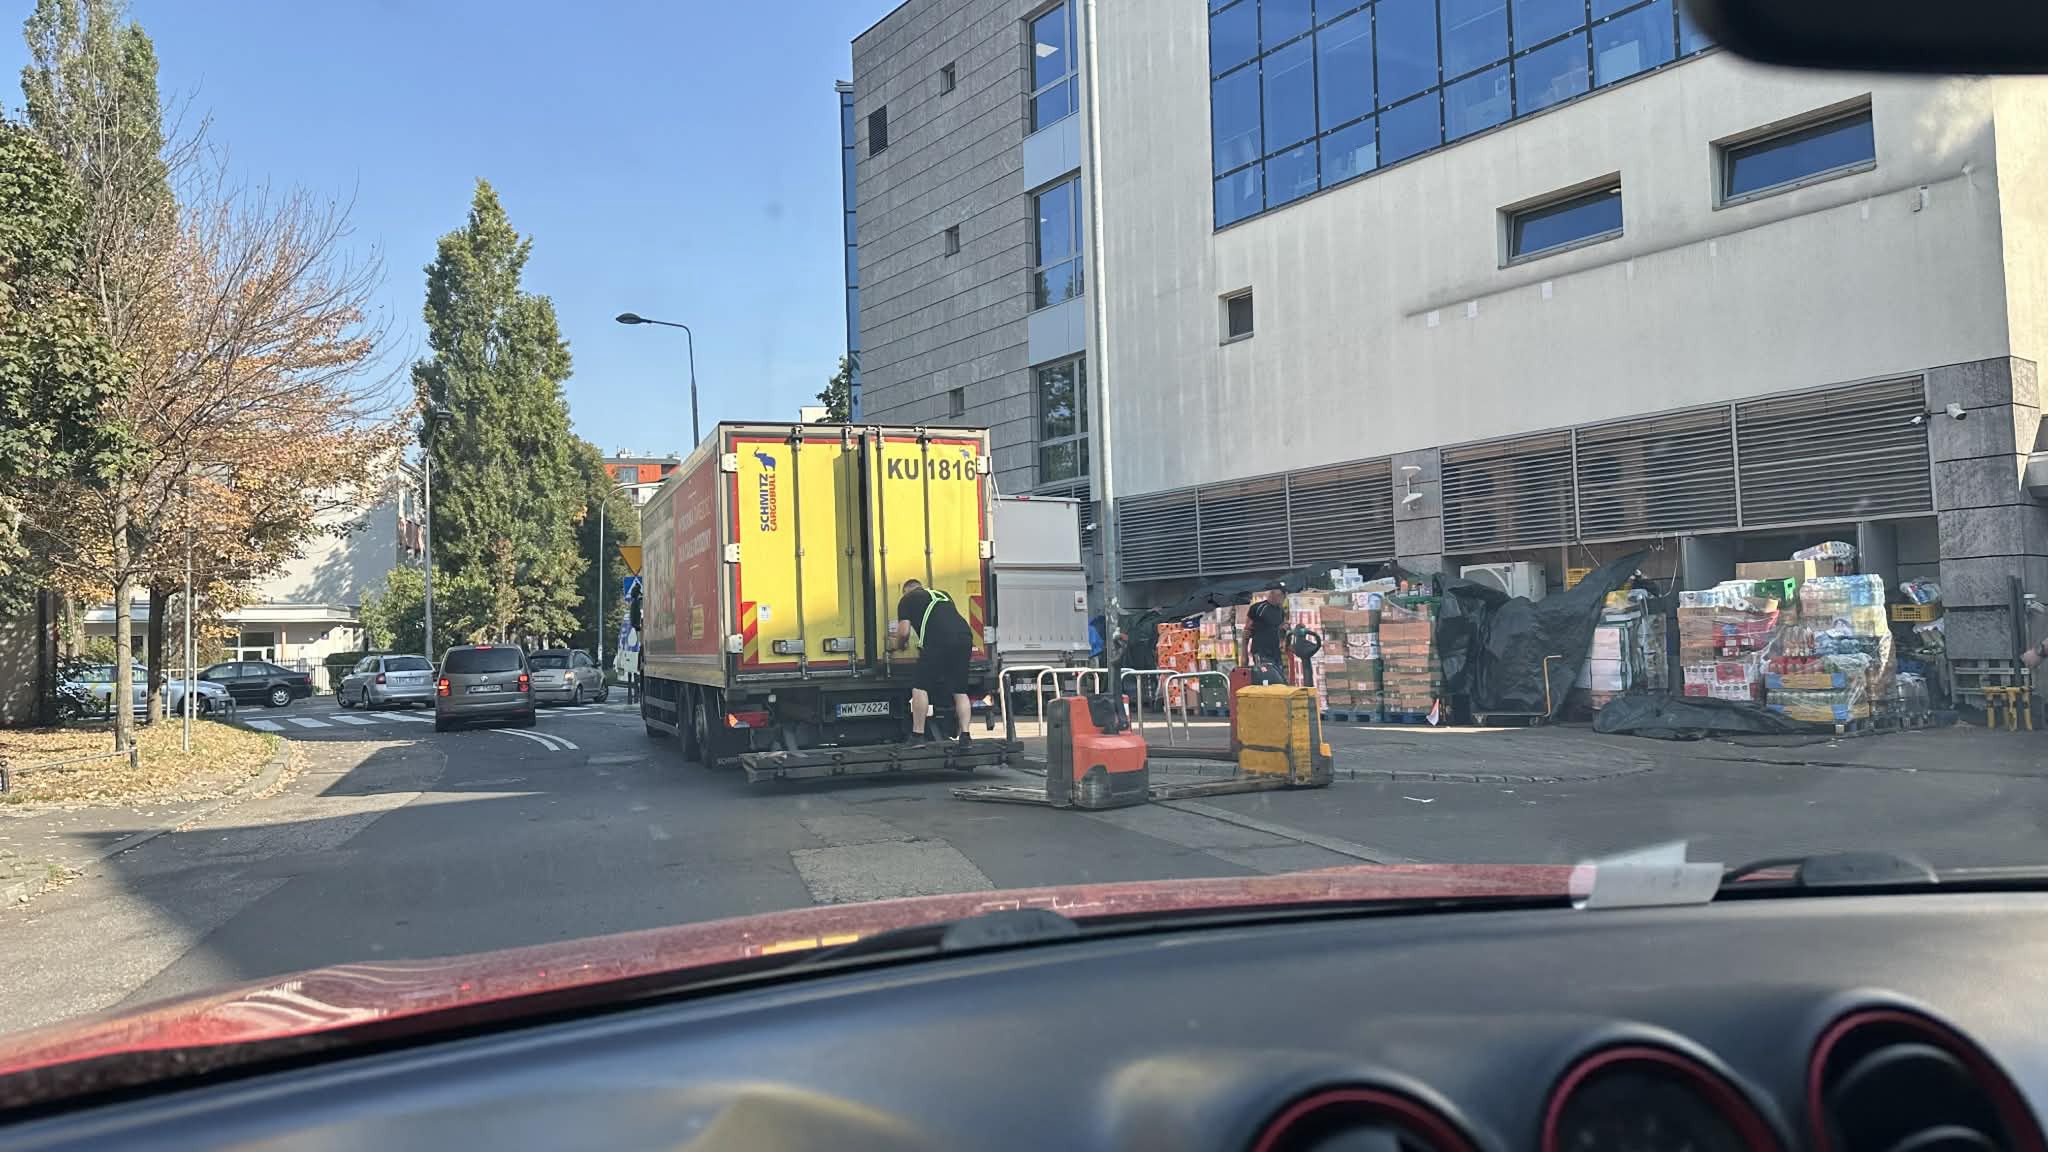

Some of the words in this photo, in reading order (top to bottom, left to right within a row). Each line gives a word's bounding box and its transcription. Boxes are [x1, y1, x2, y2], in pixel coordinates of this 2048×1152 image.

[888, 458, 919, 480] KU
[928, 458, 976, 481] 1816
[759, 473, 770, 532] SCHMITZ
[769, 473, 777, 532] CARGOBULL
